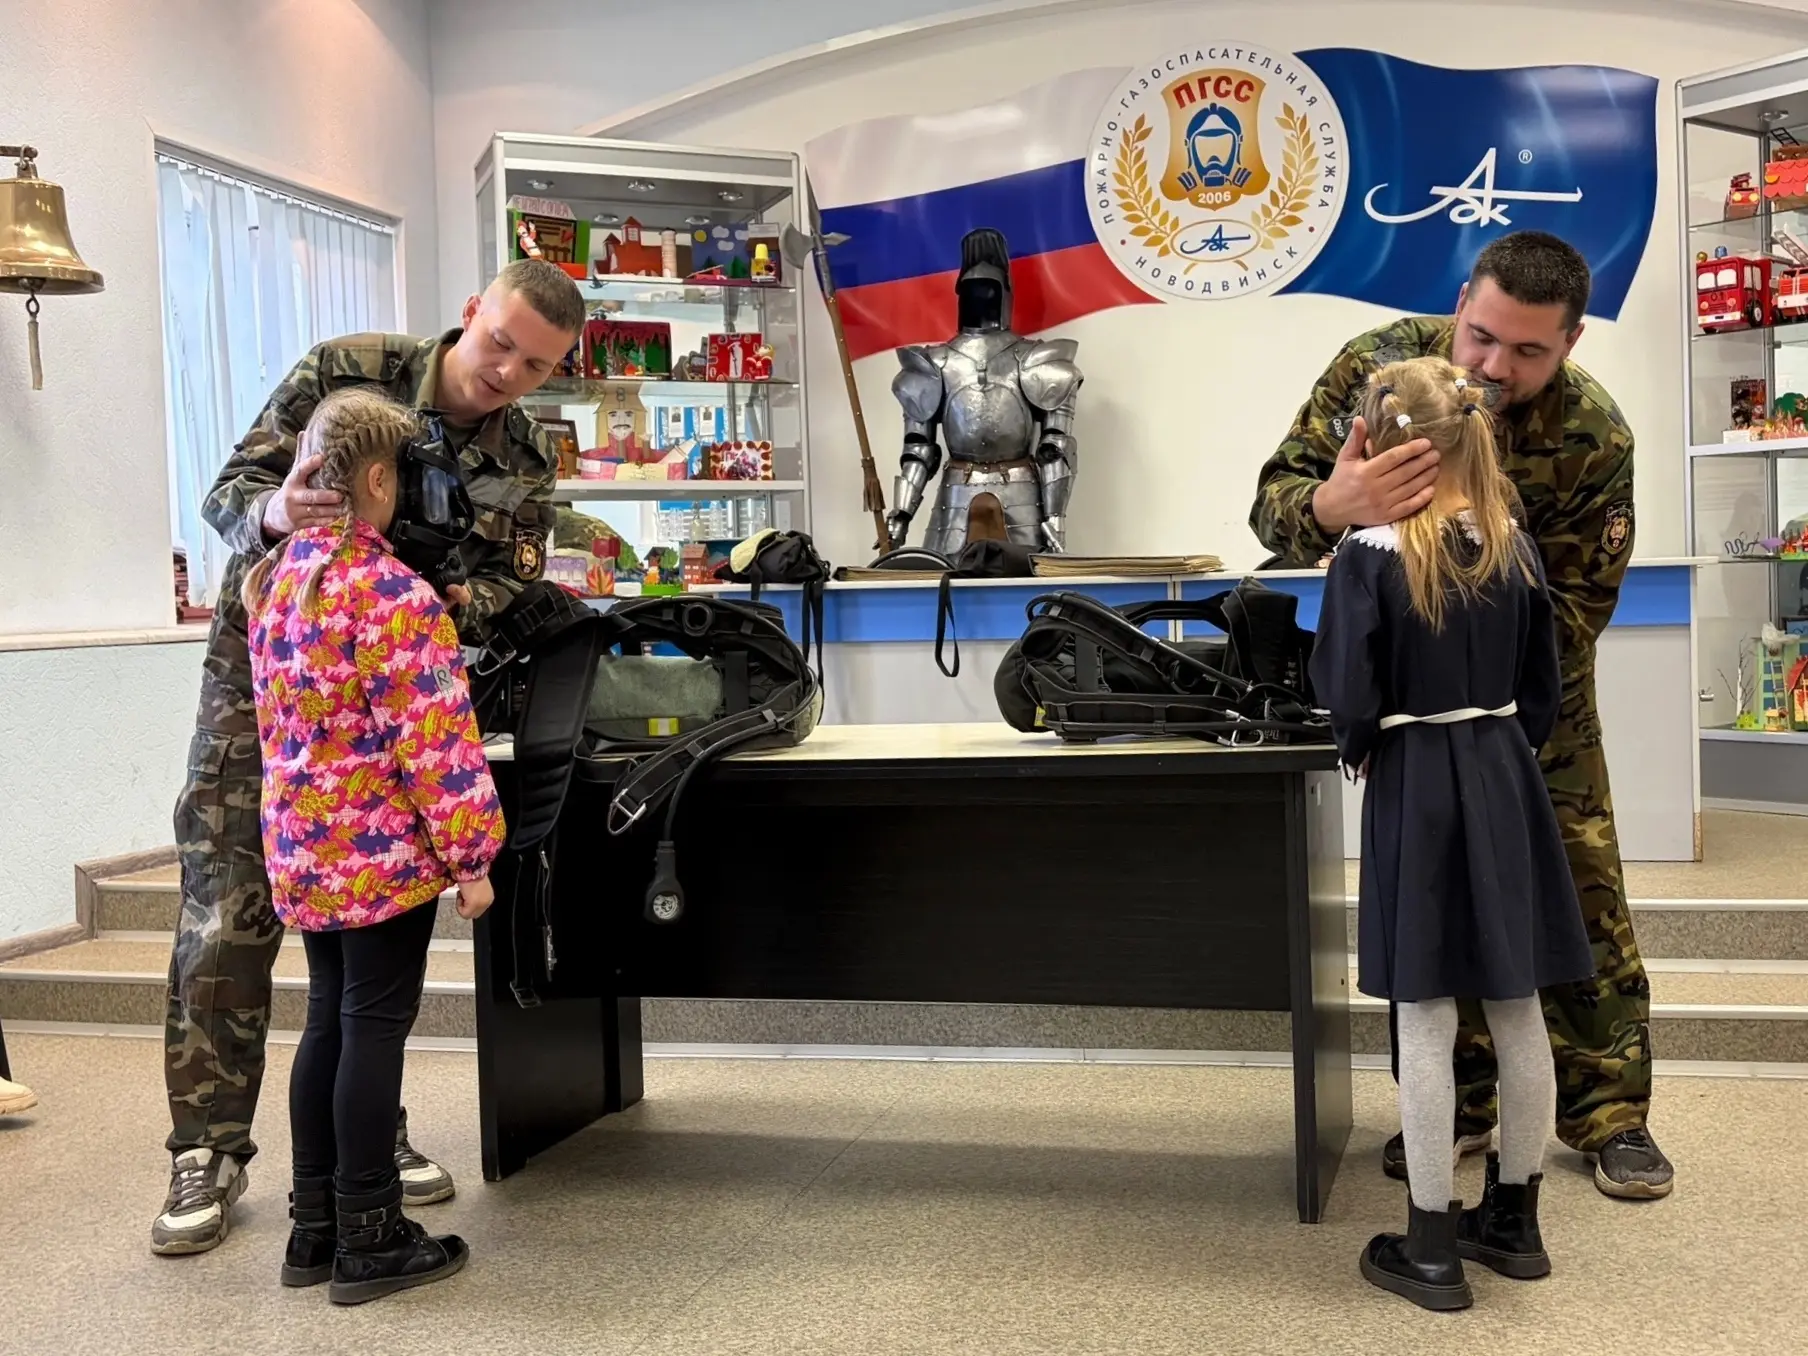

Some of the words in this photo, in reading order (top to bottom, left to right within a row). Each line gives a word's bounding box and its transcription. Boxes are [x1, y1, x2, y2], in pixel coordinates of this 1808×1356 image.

[1173, 75, 1255, 109] ПГСС
[1318, 121, 1337, 209] СЛУЖБА
[1198, 191, 1232, 205] 2006
[1135, 246, 1298, 294] НОВОДВИНСК
